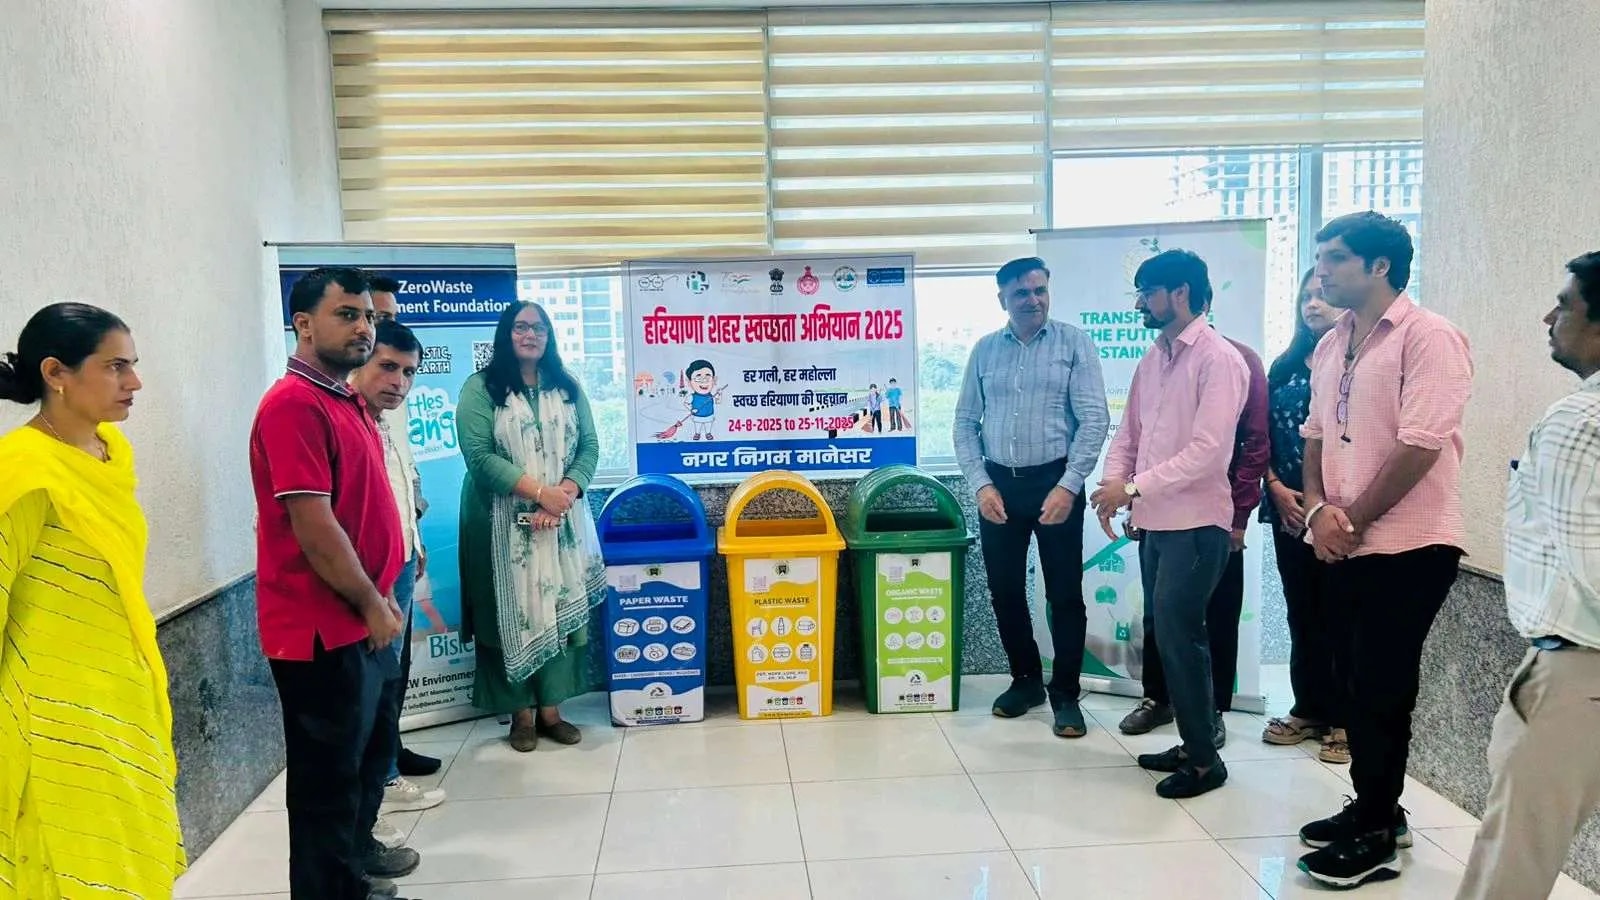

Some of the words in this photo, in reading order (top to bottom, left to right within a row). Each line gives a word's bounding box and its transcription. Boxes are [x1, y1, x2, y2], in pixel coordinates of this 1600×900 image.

[398, 280, 473, 294] ZeroWaste
[643, 306, 705, 344] हरियाणा
[708, 314, 741, 344] शहर
[743, 313, 797, 343] स्वच्छता
[800, 303, 862, 341] अभियान
[864, 309, 903, 340] 2025
[743, 369, 757, 382] हर
[758, 365, 781, 384] गली,
[783, 369, 797, 382] हर
[798, 365, 837, 381] महोल्ला
[732, 394, 758, 408] स्वच्छ
[760, 390, 799, 407] हरियाणा
[801, 389, 814, 406] की
[816, 392, 849, 406] पहचान
[728, 418, 782, 432] 24-8-2025
[784, 418, 796, 431] to
[798, 416, 854, 431] 25-11-2025
[680, 451, 729, 467] नगर
[732, 446, 792, 467] निगम
[795, 444, 872, 465] मानेसर
[619, 596, 651, 606] PAPER
[652, 595, 689, 604] WASTE
[754, 597, 783, 605] PLASTIC
[784, 596, 810, 604] WASTE
[422, 670, 476, 687] Environmen
